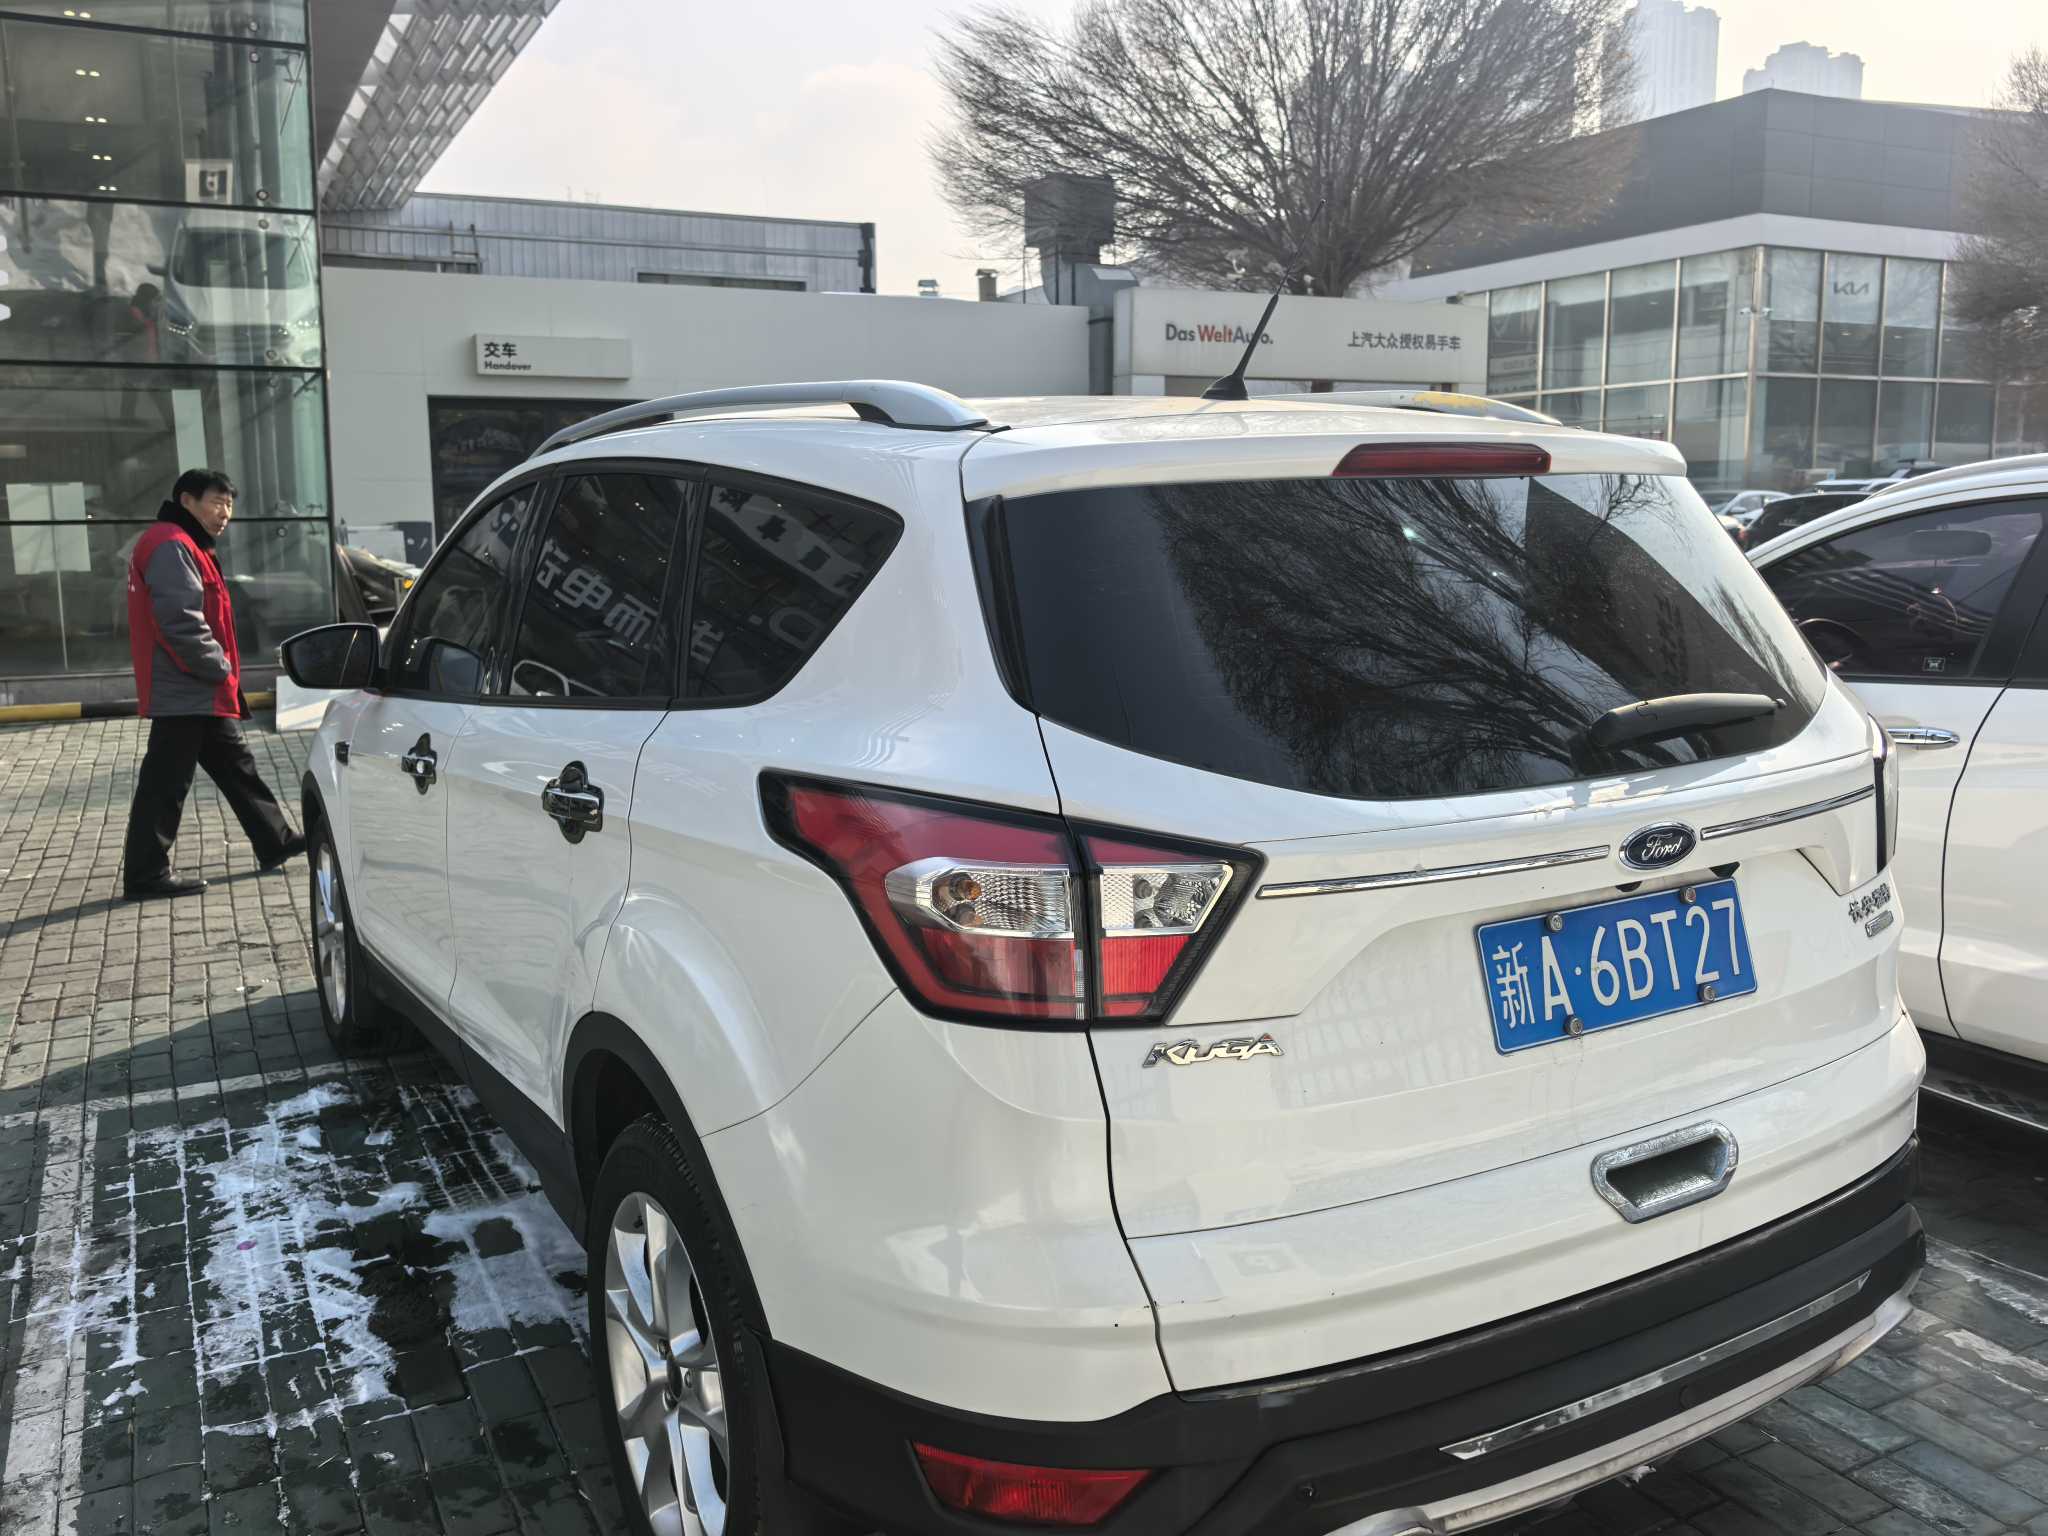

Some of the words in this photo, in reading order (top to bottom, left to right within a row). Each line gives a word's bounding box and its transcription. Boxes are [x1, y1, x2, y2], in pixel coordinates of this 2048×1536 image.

[1165, 322, 1196, 342] Das
[1197, 324, 1274, 346] WeltAuo.
[484, 341, 518, 359] 交车
[484, 360, 532, 371] Handover
[1641, 832, 1684, 861] Ford
[1492, 897, 1742, 1030] 新A·6BT27
[1142, 1032, 1286, 1069] KUGA
